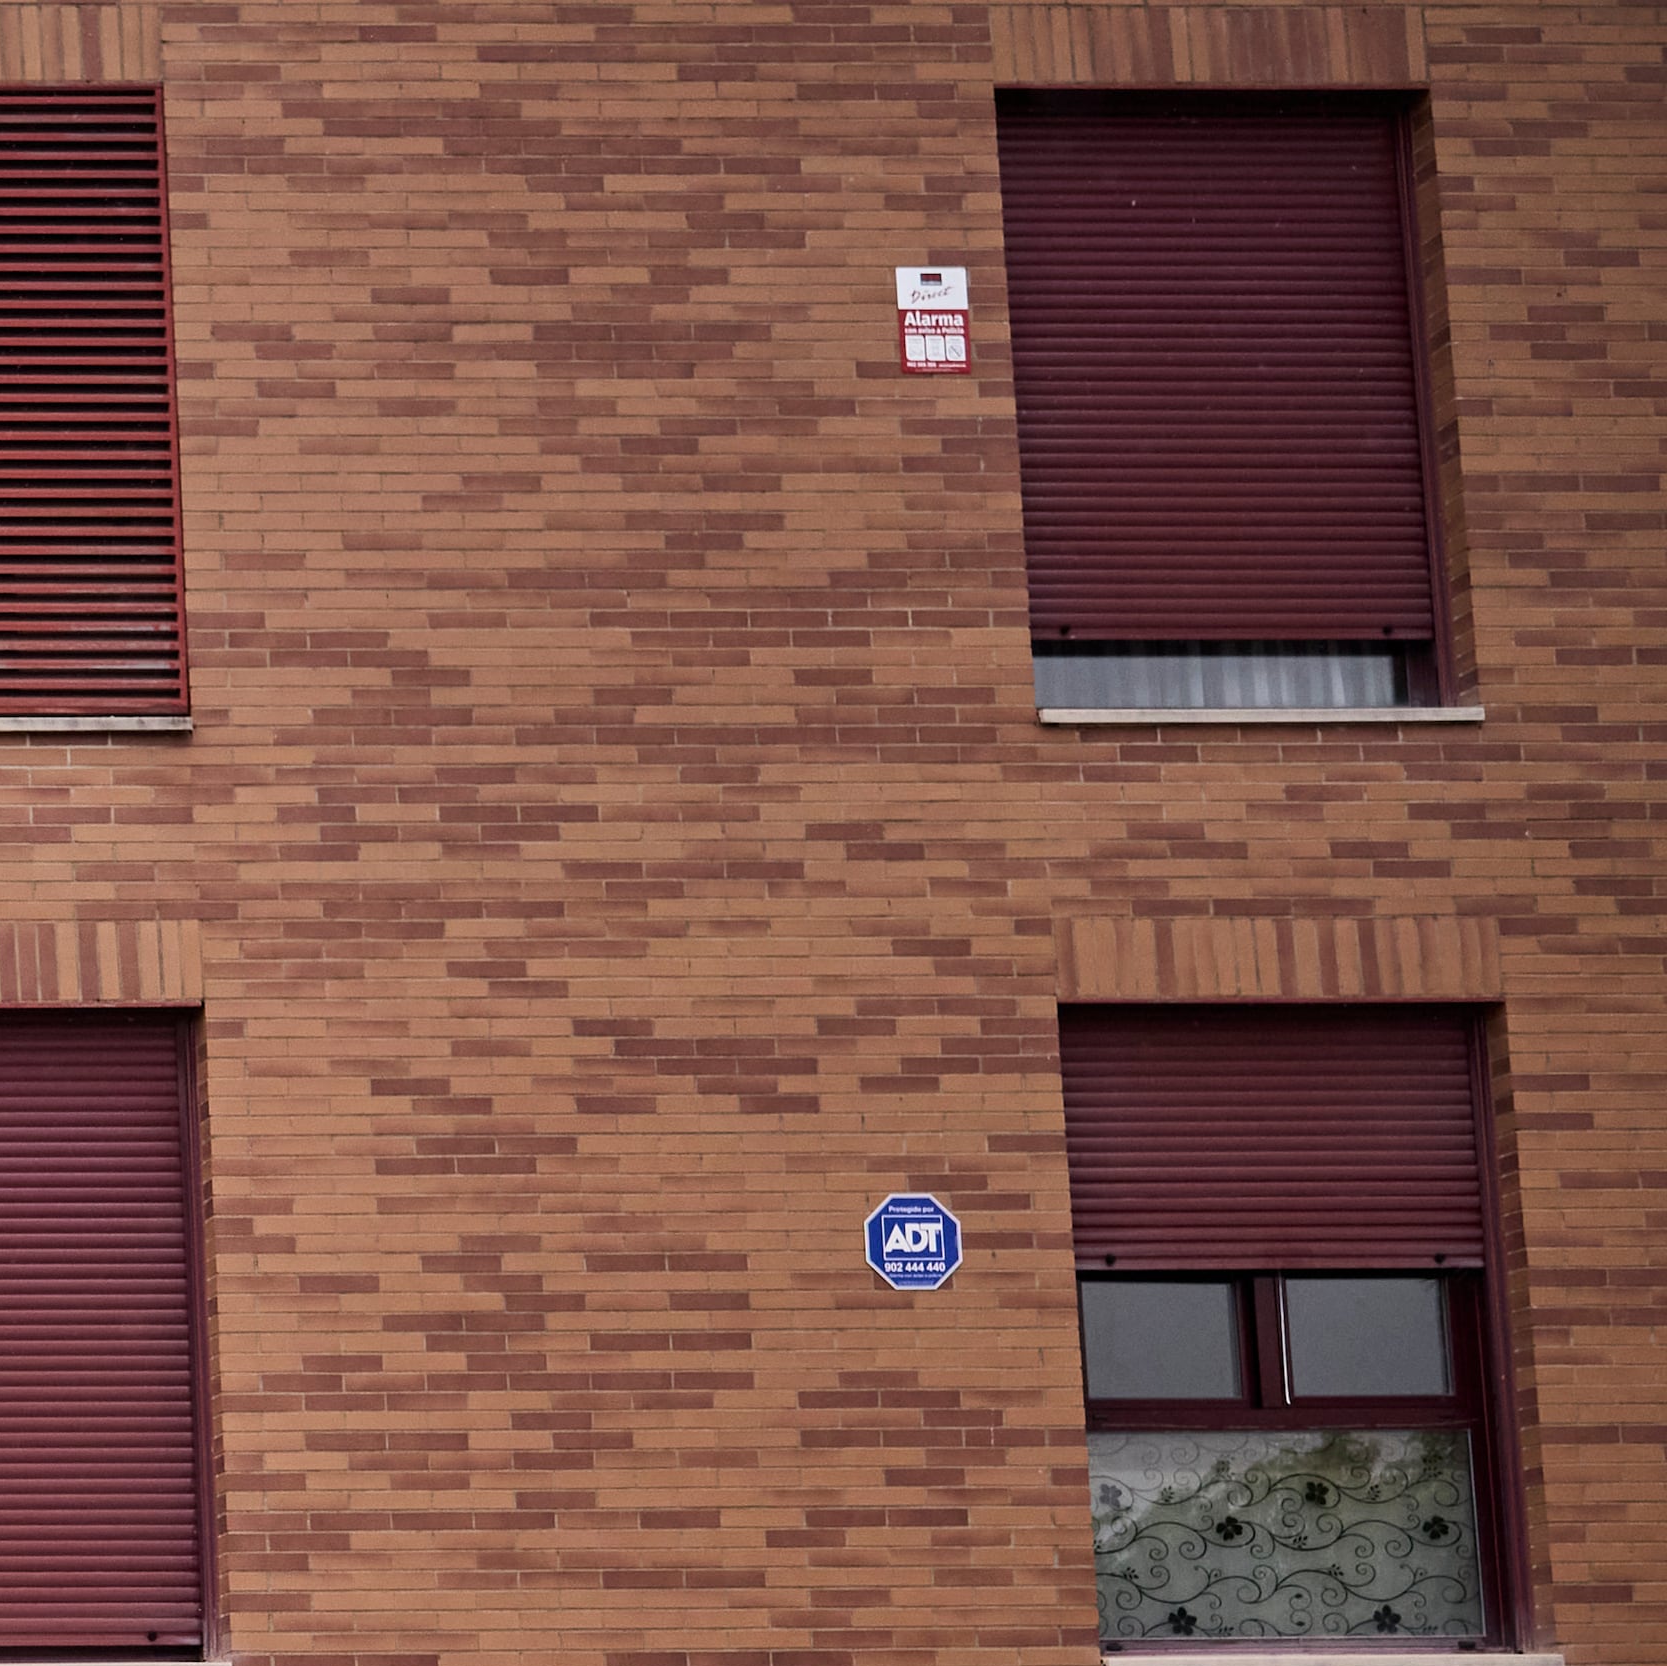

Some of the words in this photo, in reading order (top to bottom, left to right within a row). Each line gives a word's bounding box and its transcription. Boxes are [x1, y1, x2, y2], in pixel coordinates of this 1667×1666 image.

[904, 310, 964, 326] Alarma
[888, 1205, 921, 1214] Protegido
[885, 1223, 942, 1253] ADT
[884, 1262, 903, 1272] 902
[905, 1262, 924, 1272] 444
[926, 1262, 946, 1272] 440
